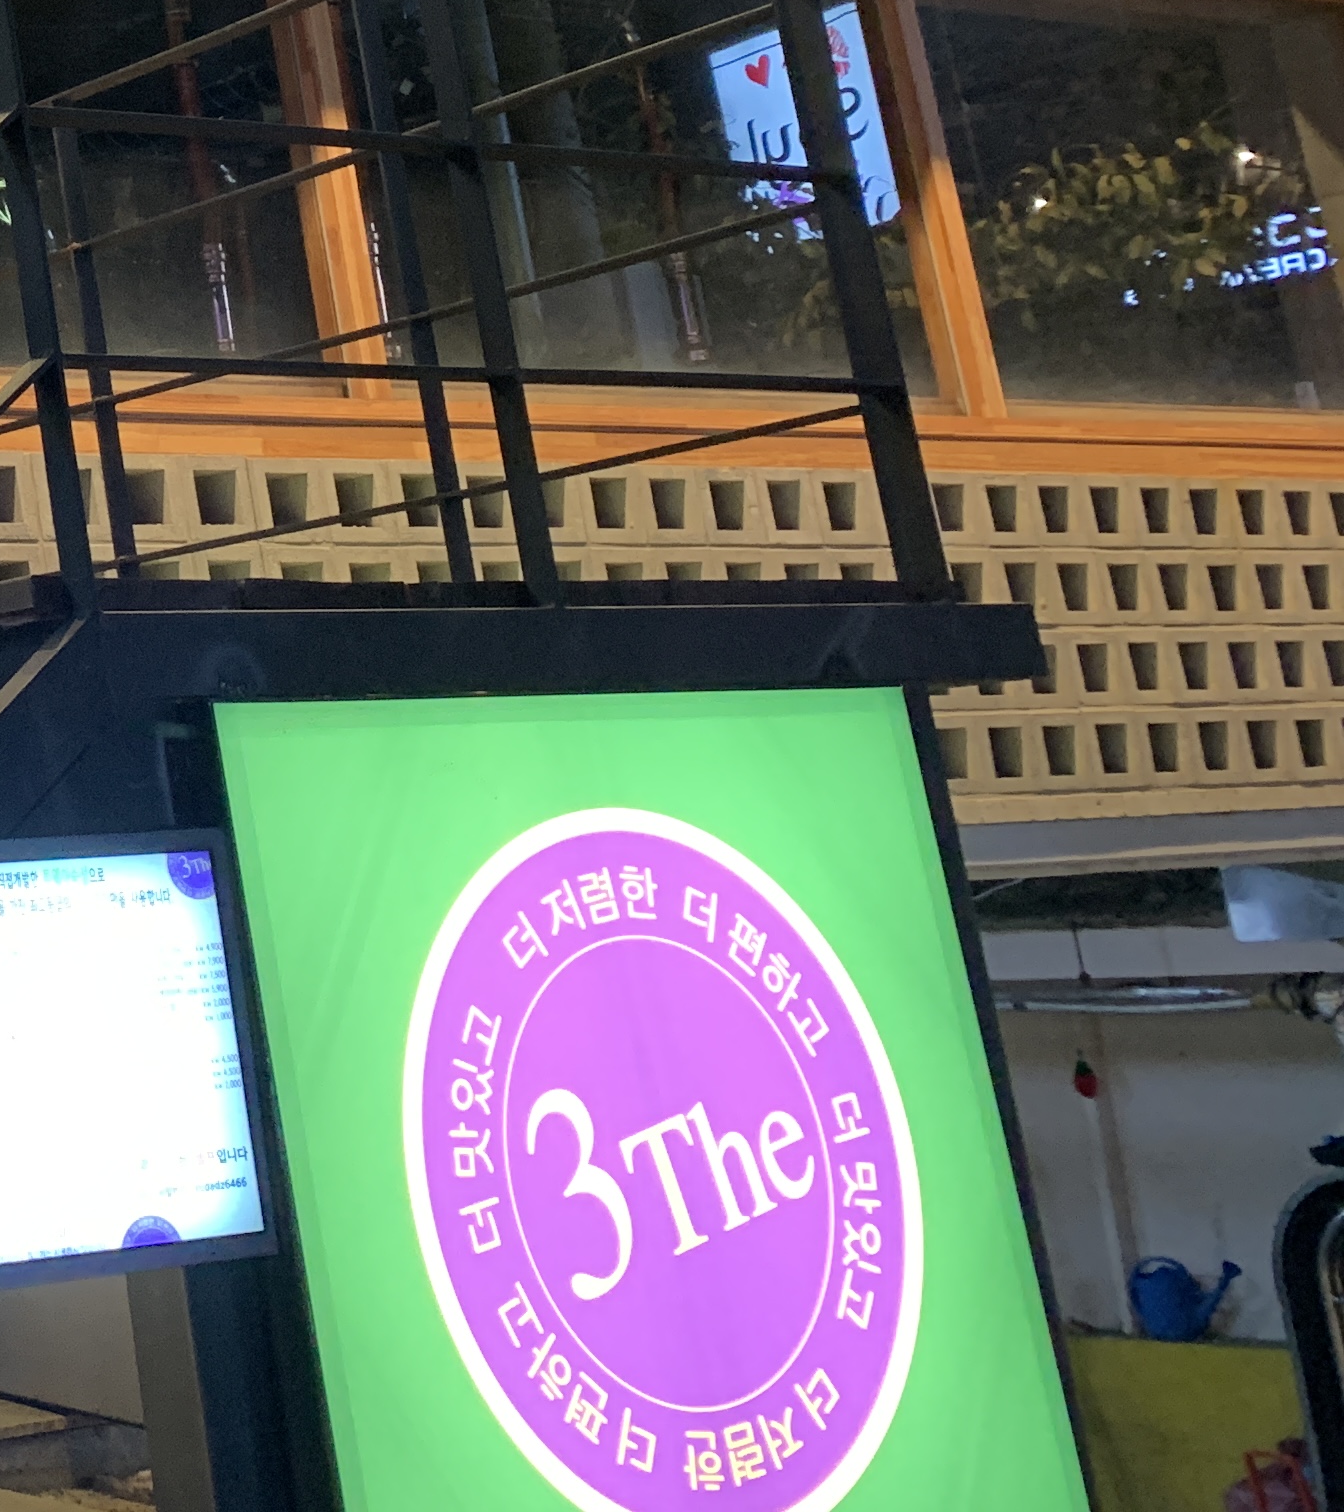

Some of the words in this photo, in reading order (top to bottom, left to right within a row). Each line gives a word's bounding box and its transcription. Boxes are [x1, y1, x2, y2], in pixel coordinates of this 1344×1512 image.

[540, 865, 658, 937] 저렴한
[684, 885, 717, 943] 더
[502, 911, 550, 969] 더
[726, 913, 830, 1057] 편하고
[449, 1003, 502, 1178] 맛있고
[831, 1092, 869, 1143] 더
[458, 1196, 501, 1254] 더
[525, 1088, 815, 1302] 3The
[838, 1160, 882, 1330] 맛있고
[497, 1281, 609, 1445] 편하고
[793, 1368, 841, 1431] 더
[617, 1407, 657, 1473] 더
[685, 1406, 804, 1492] 저렴한
